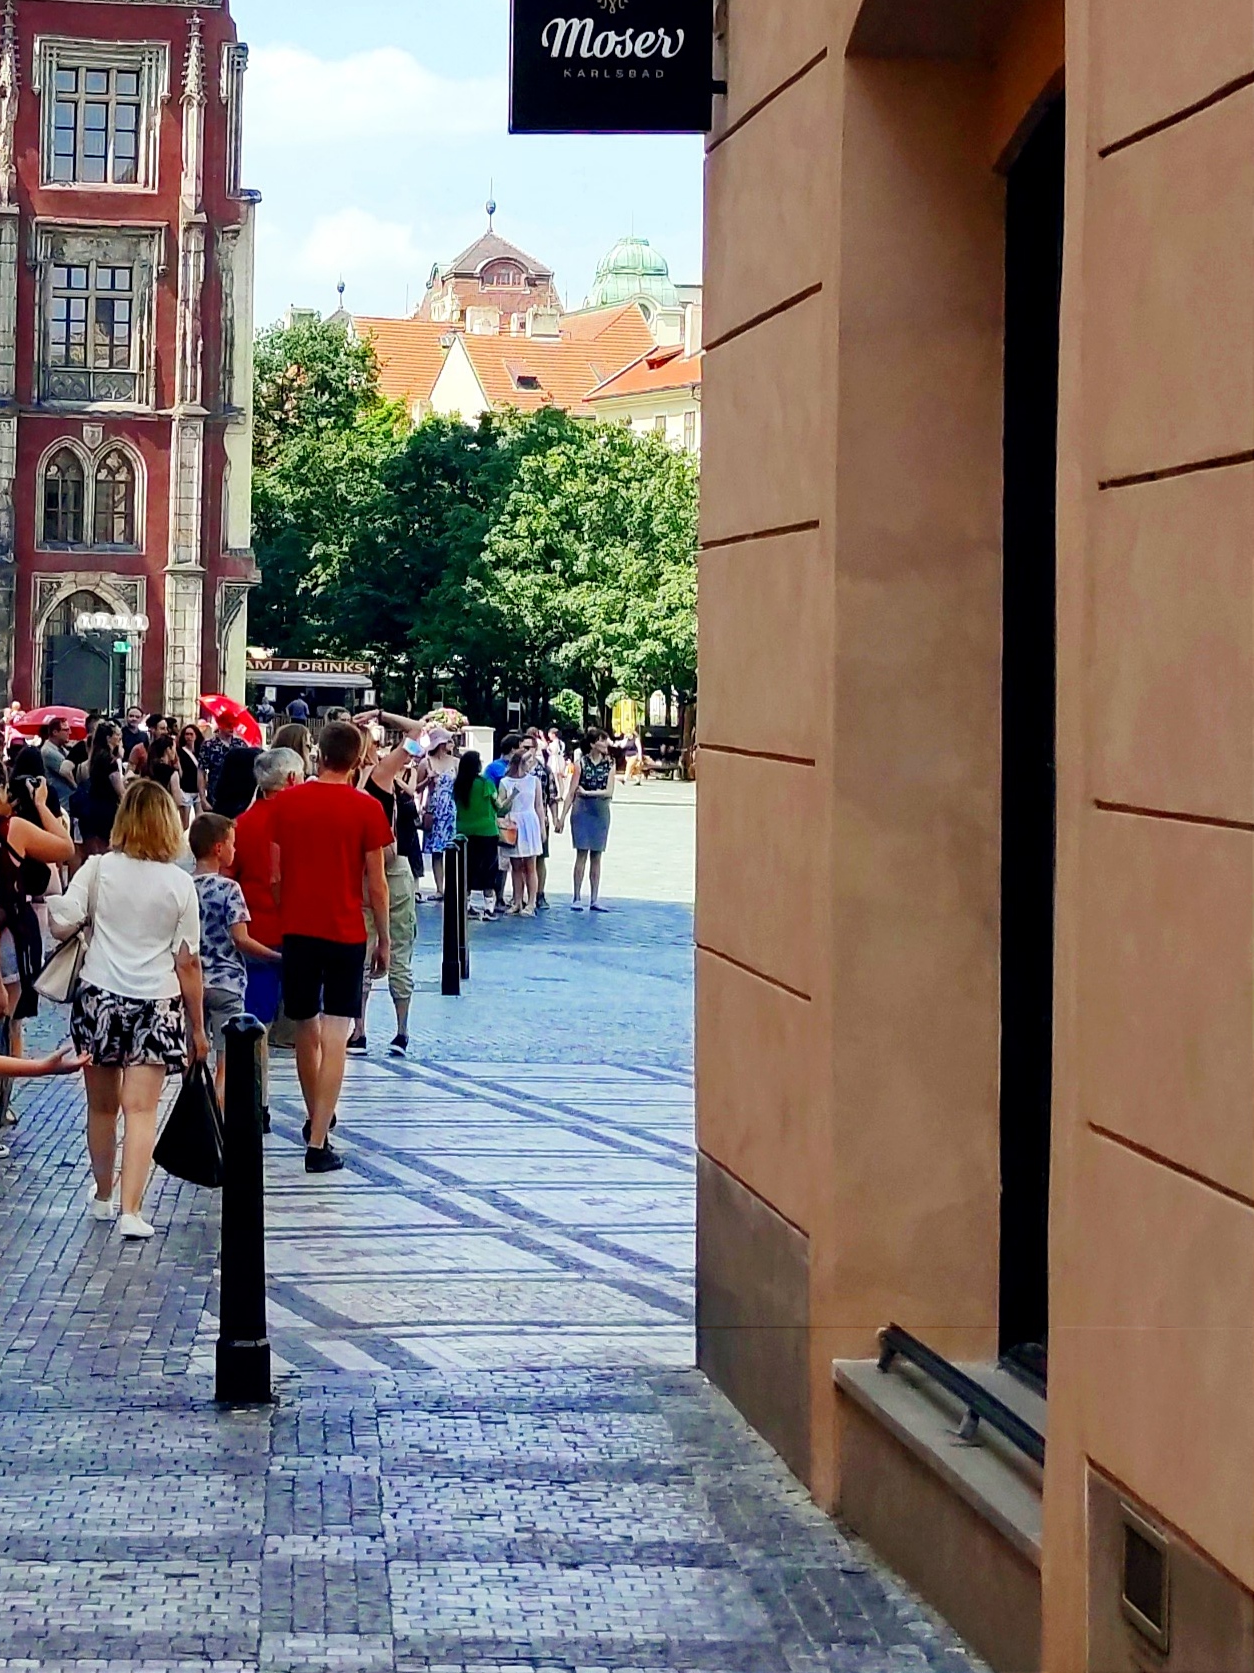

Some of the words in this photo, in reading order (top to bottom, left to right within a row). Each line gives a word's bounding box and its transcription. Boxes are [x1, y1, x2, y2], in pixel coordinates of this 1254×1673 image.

[541, 17, 685, 58] Moser
[563, 68, 664, 78] KARLSBAD
[297, 661, 366, 673] DRINKS
